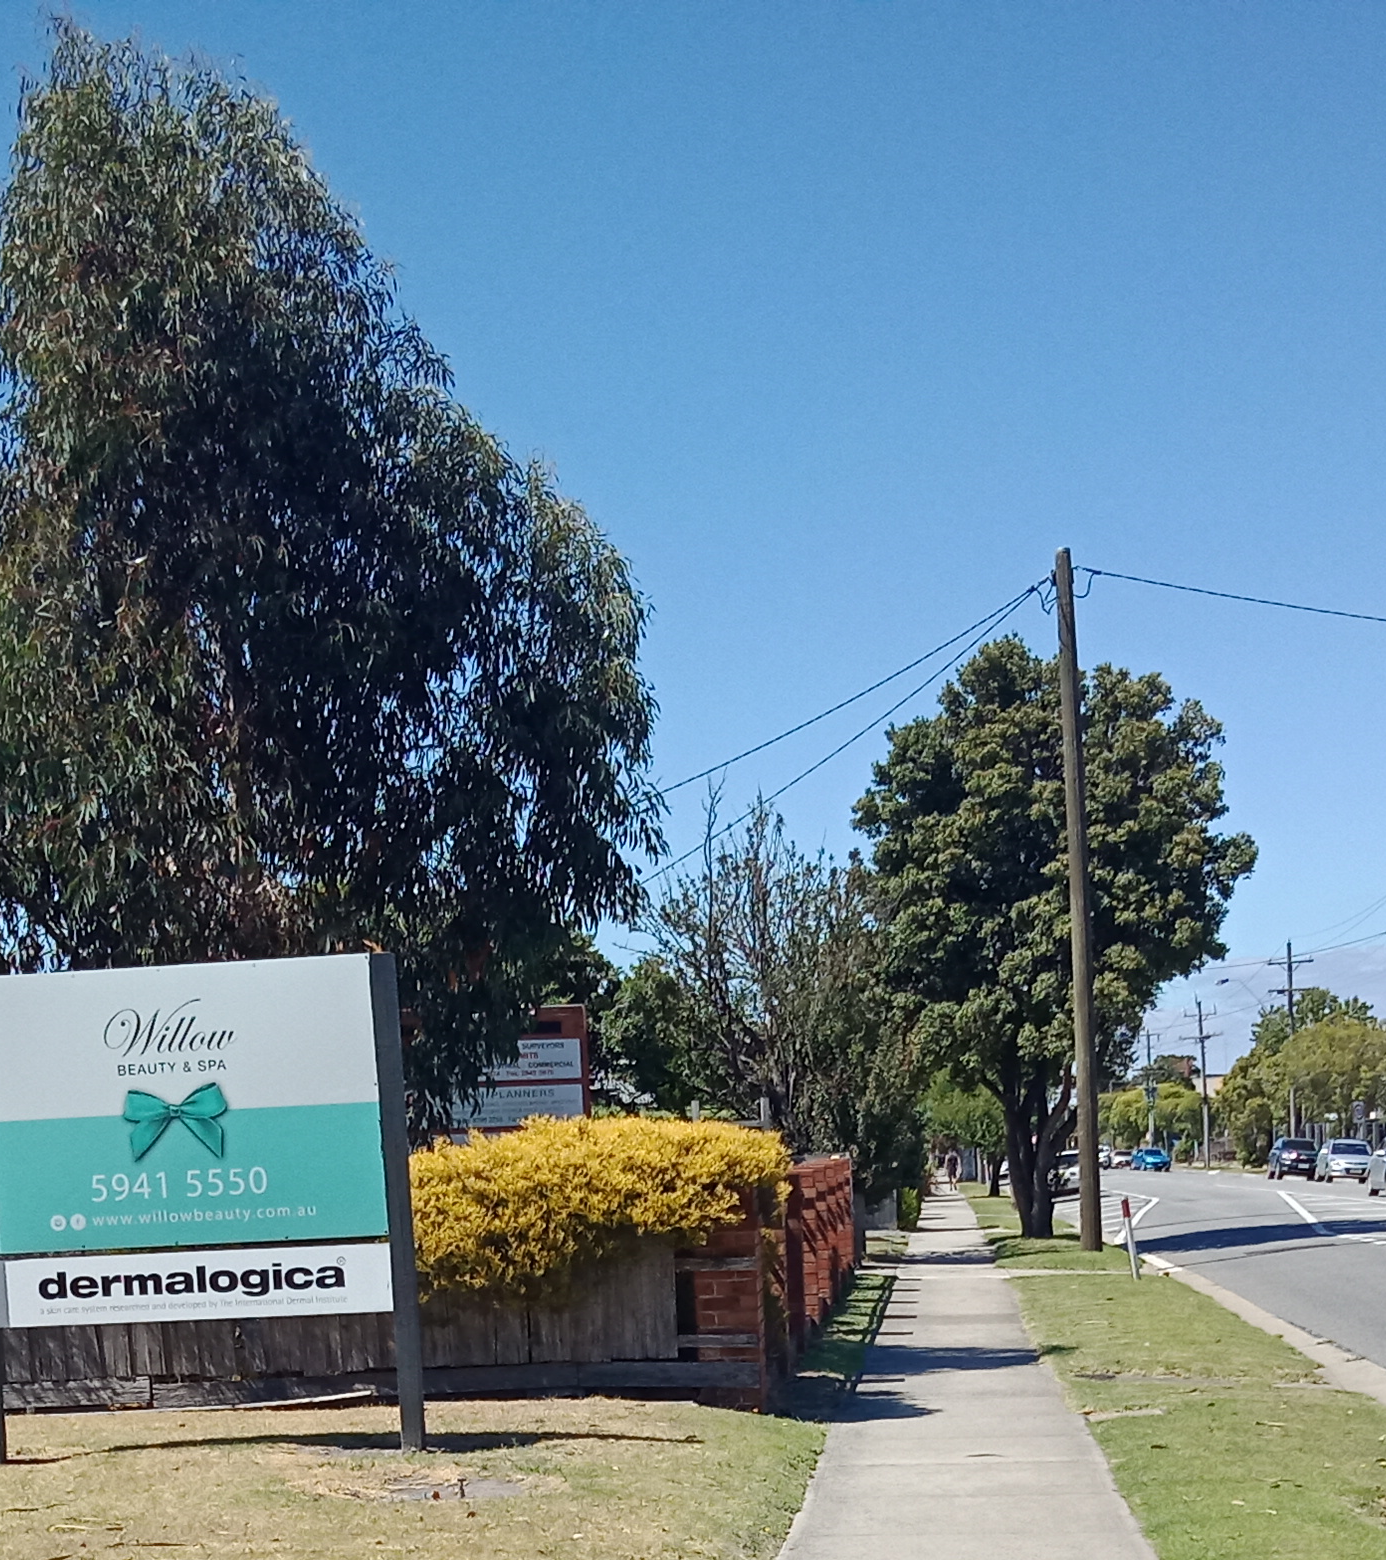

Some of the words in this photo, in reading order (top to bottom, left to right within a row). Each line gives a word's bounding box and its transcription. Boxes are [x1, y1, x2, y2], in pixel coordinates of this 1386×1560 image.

[103, 998, 236, 1057] Willow
[117, 1062, 177, 1077] BEAUTY
[182, 1061, 193, 1073] &
[197, 1059, 227, 1072] SPA
[91, 1171, 168, 1202] 5941
[186, 1166, 268, 1198] 5550
[92, 1205, 316, 1226] www.willowbeauty.com.au
[39, 1263, 346, 1300] dermalogica
